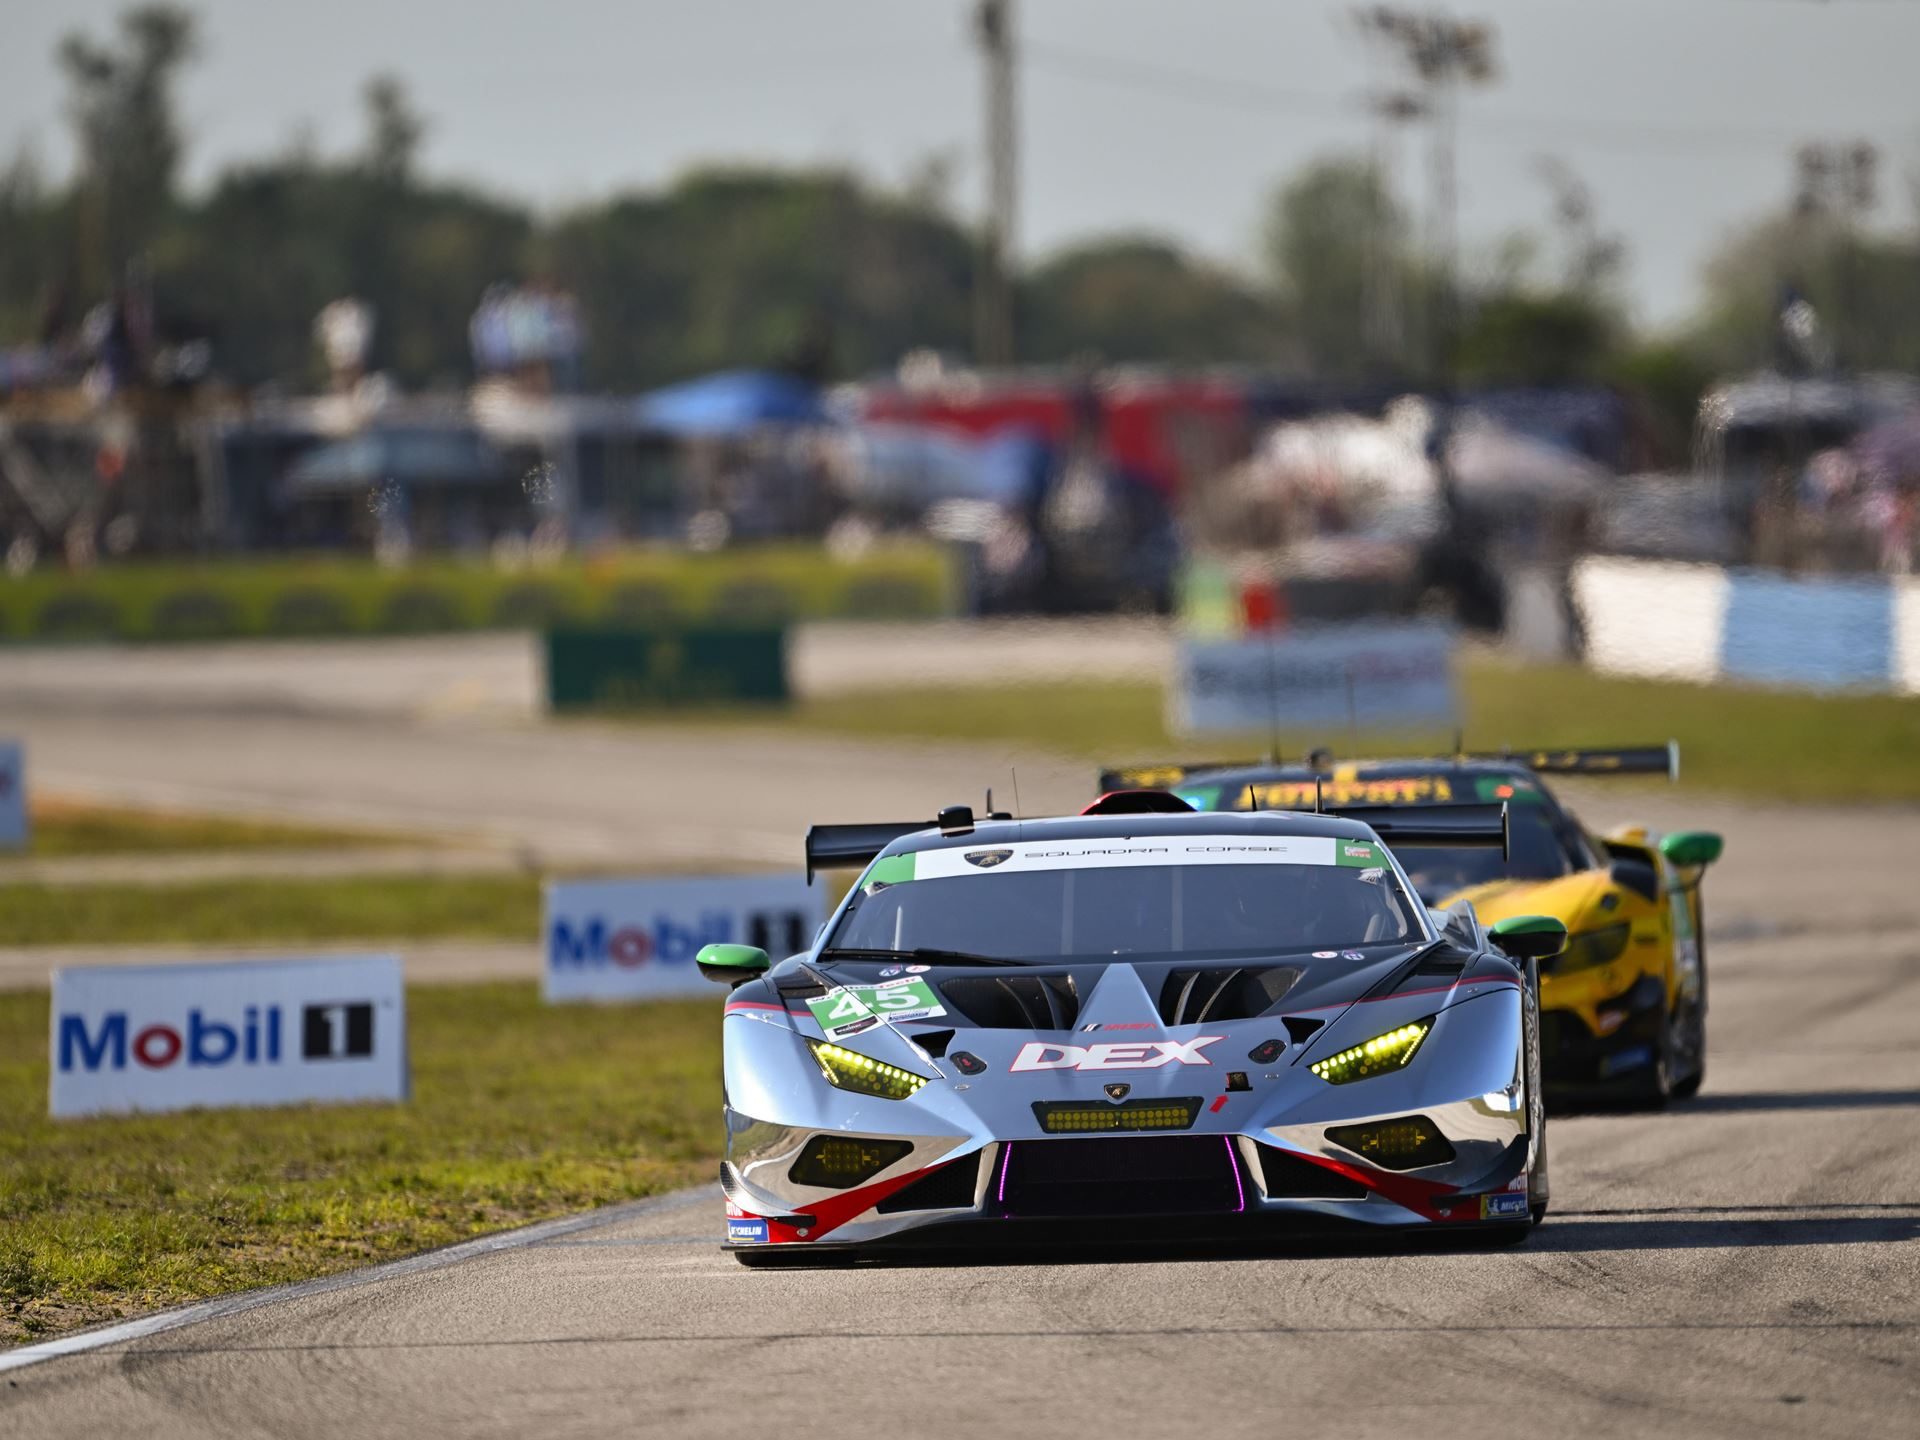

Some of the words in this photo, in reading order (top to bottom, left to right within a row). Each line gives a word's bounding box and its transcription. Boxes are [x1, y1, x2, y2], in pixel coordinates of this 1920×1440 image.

[1024, 847, 1169, 858] SQUADRA
[551, 908, 731, 970] Mobil
[829, 987, 920, 1019] 45
[58, 1004, 282, 1073] Mobil
[1009, 1036, 1227, 1072] DEX
